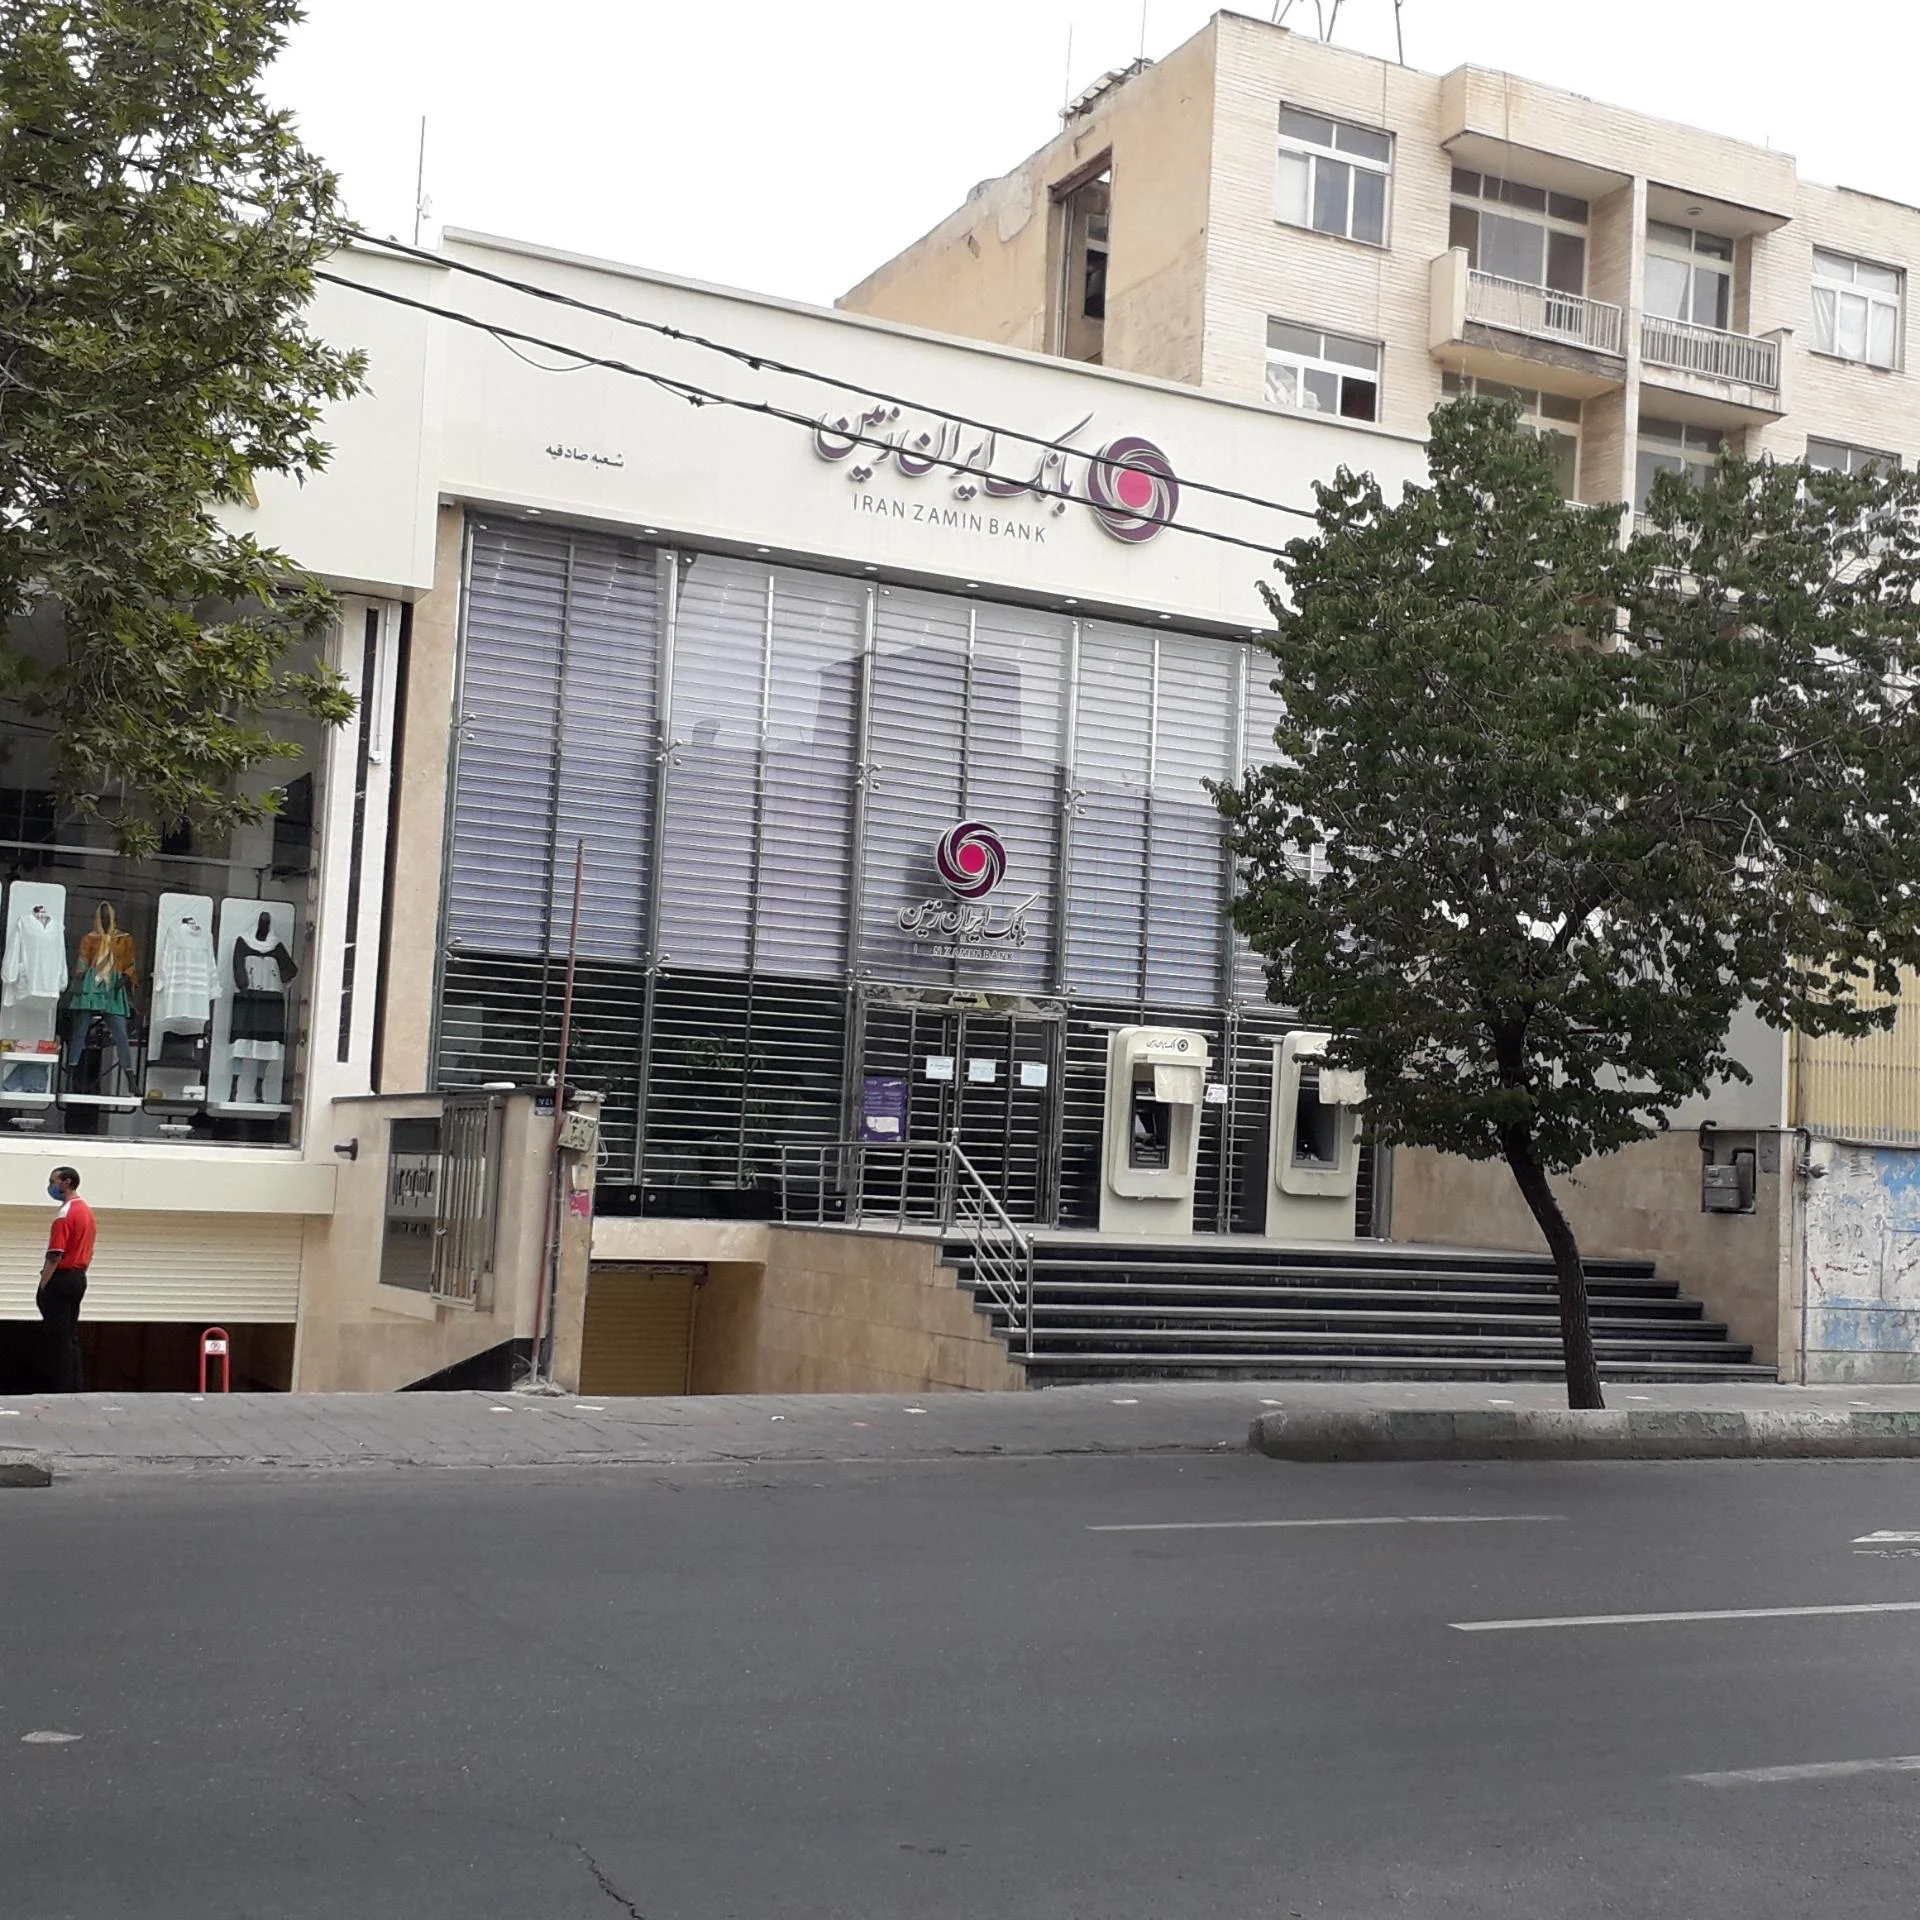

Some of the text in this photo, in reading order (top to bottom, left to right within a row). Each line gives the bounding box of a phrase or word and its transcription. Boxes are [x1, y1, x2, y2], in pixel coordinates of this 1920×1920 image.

[545, 443, 625, 470] شعبه صادقیه
[814, 404, 1095, 517] بانک ایران زمین
[852, 492, 1048, 544] IRAN ZAMIN BANK
[897, 892, 1040, 947] بانک ایران زمین
[983, 949, 1014, 961] BANK
